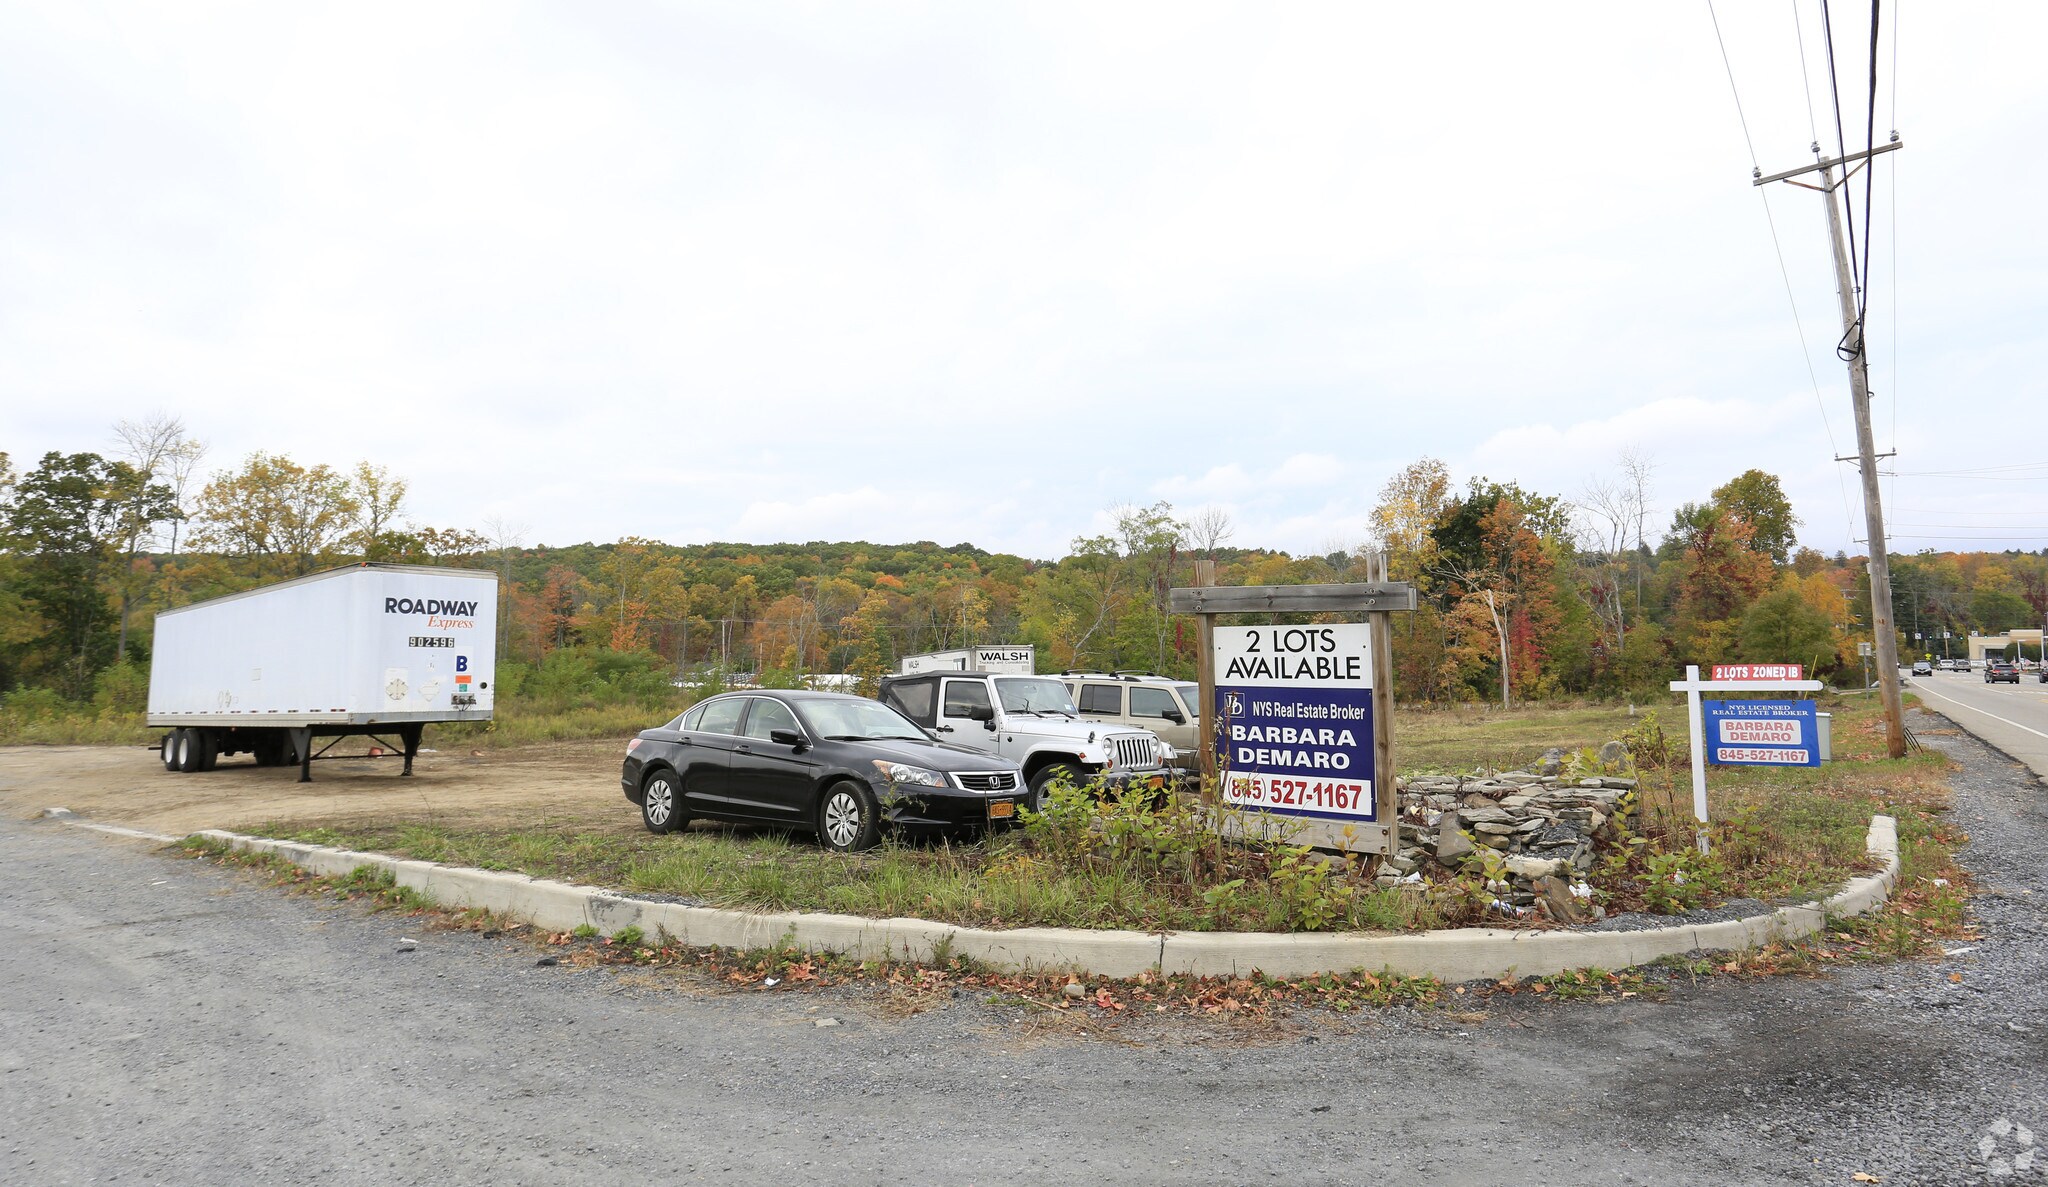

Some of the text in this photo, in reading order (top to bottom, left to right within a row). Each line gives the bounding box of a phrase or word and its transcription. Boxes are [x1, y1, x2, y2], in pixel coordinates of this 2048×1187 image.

[385, 597, 478, 616] ROADWAY
[427, 616, 474, 630] Express
[410, 637, 454, 647] 902596
[1246, 629, 1336, 652] 2 LOTS
[456, 655, 467, 672] B
[980, 652, 1028, 660] WALSH
[1225, 657, 1361, 680] AVAILABLE
[1716, 667, 1798, 678] 2 LOTS ZONED IB
[1253, 701, 1365, 720] NYS Real Estate Broker
[1725, 722, 1794, 731] BARBARA
[1232, 725, 1357, 746] BARBARA
[1730, 732, 1791, 741] DEMARO
[1238, 748, 1350, 770] DEMARO
[1720, 749, 1806, 761] 845-527-1167
[1270, 780, 1361, 809] 527-1167
